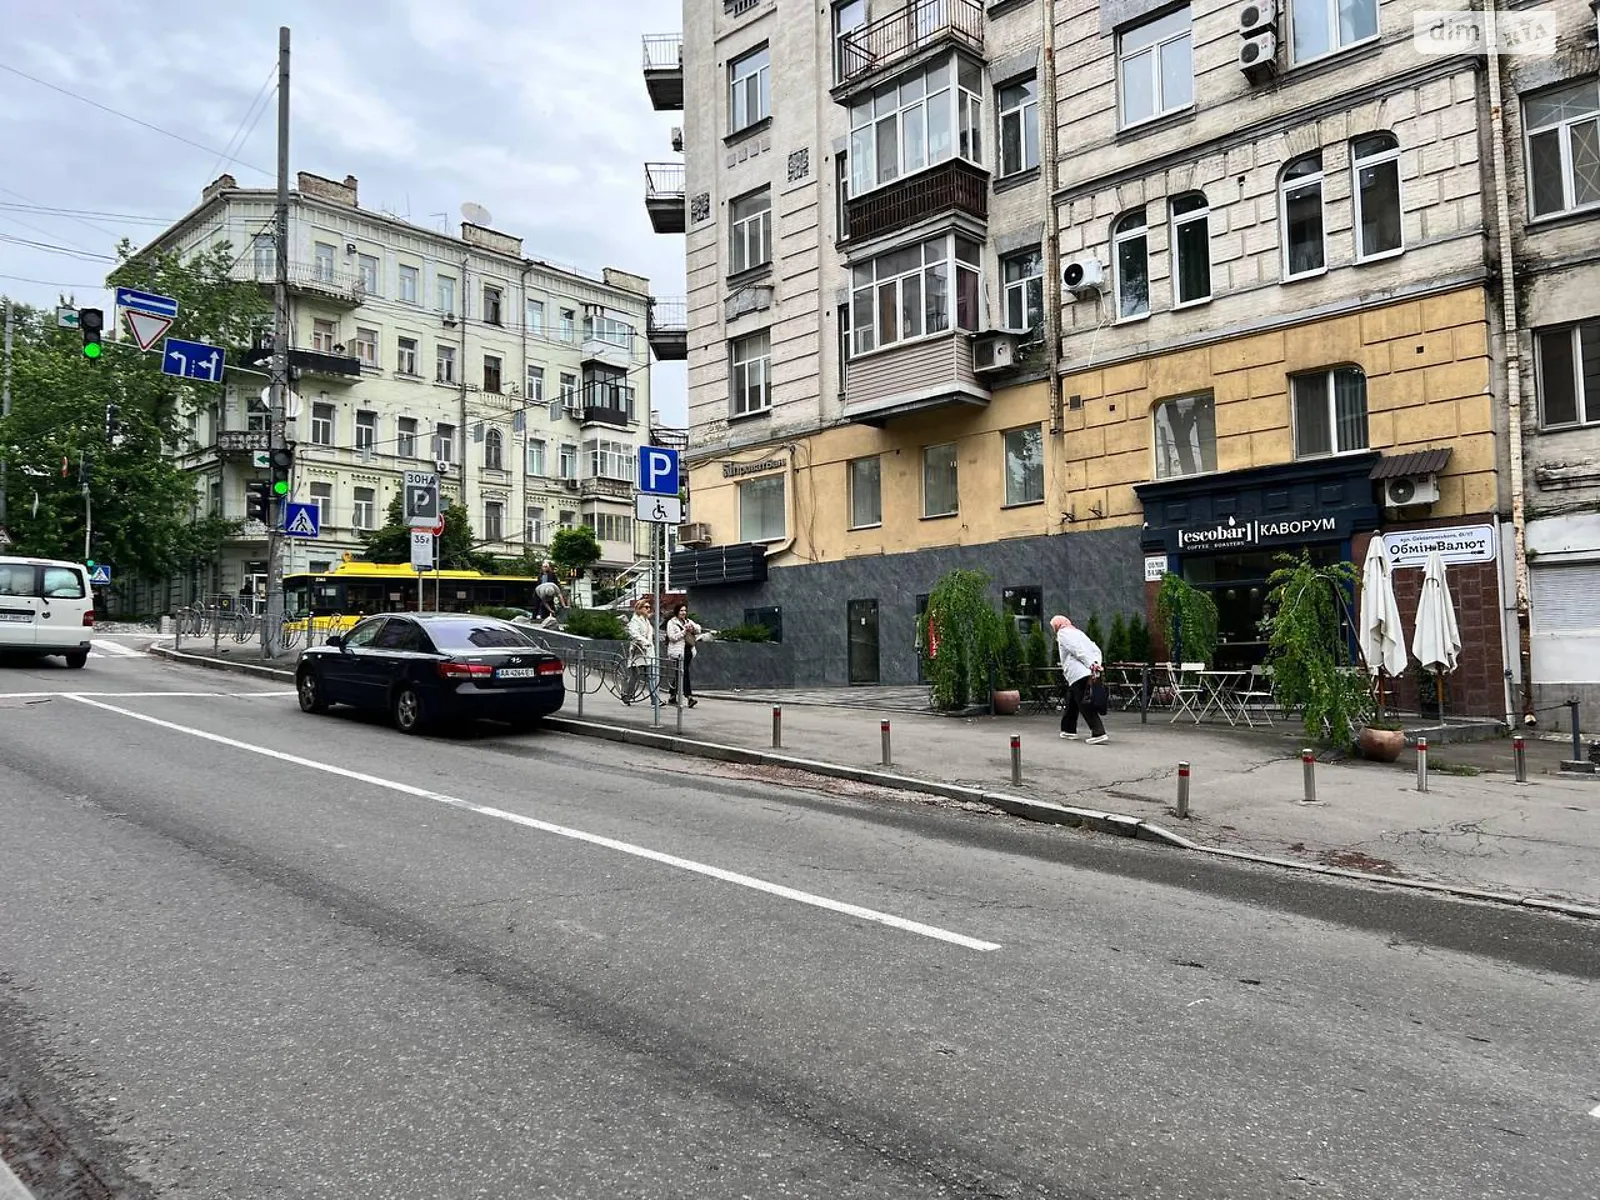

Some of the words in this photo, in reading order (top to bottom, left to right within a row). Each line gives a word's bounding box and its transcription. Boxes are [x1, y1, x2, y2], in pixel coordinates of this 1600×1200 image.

[407, 473, 436, 485] ЗОНА
[649, 452, 672, 489] P
[413, 489, 430, 514] P
[1260, 517, 1336, 536] КАВОРУМ
[1186, 543, 1209, 551] COFFEE
[1214, 540, 1245, 549] ROASTERS
[1389, 541, 1432, 555] Обмін
[1436, 539, 1486, 552] Валют
